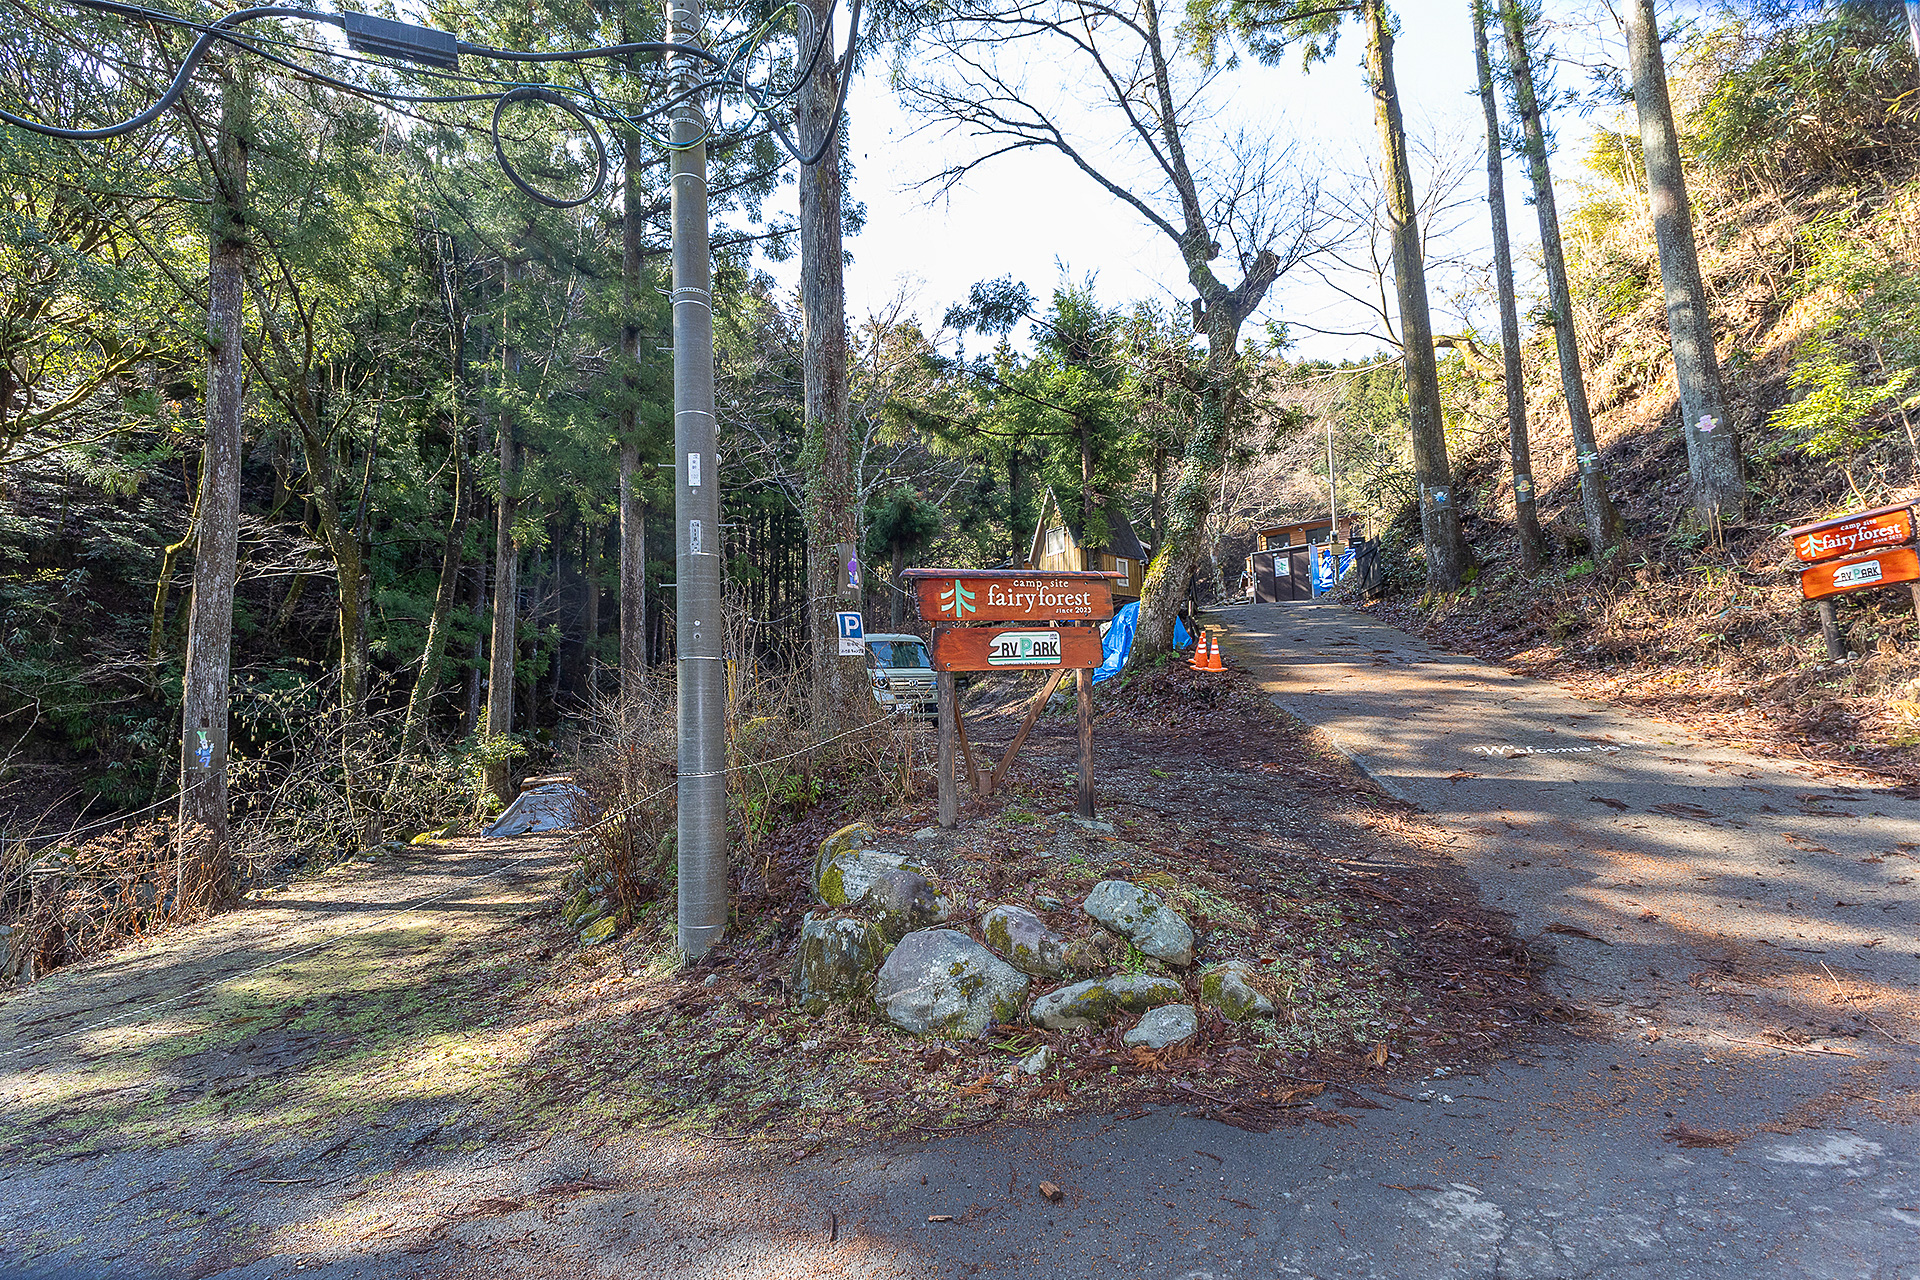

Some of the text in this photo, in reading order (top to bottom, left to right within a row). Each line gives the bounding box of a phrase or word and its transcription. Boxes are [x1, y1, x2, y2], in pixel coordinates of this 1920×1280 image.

[1840, 522, 1861, 531] camp
[1853, 567, 1879, 580] PARK
[1013, 578, 1069, 590] camp site
[987, 584, 1091, 613] fairyforest
[844, 616, 859, 636] P
[1002, 638, 1058, 659] RV PARK
